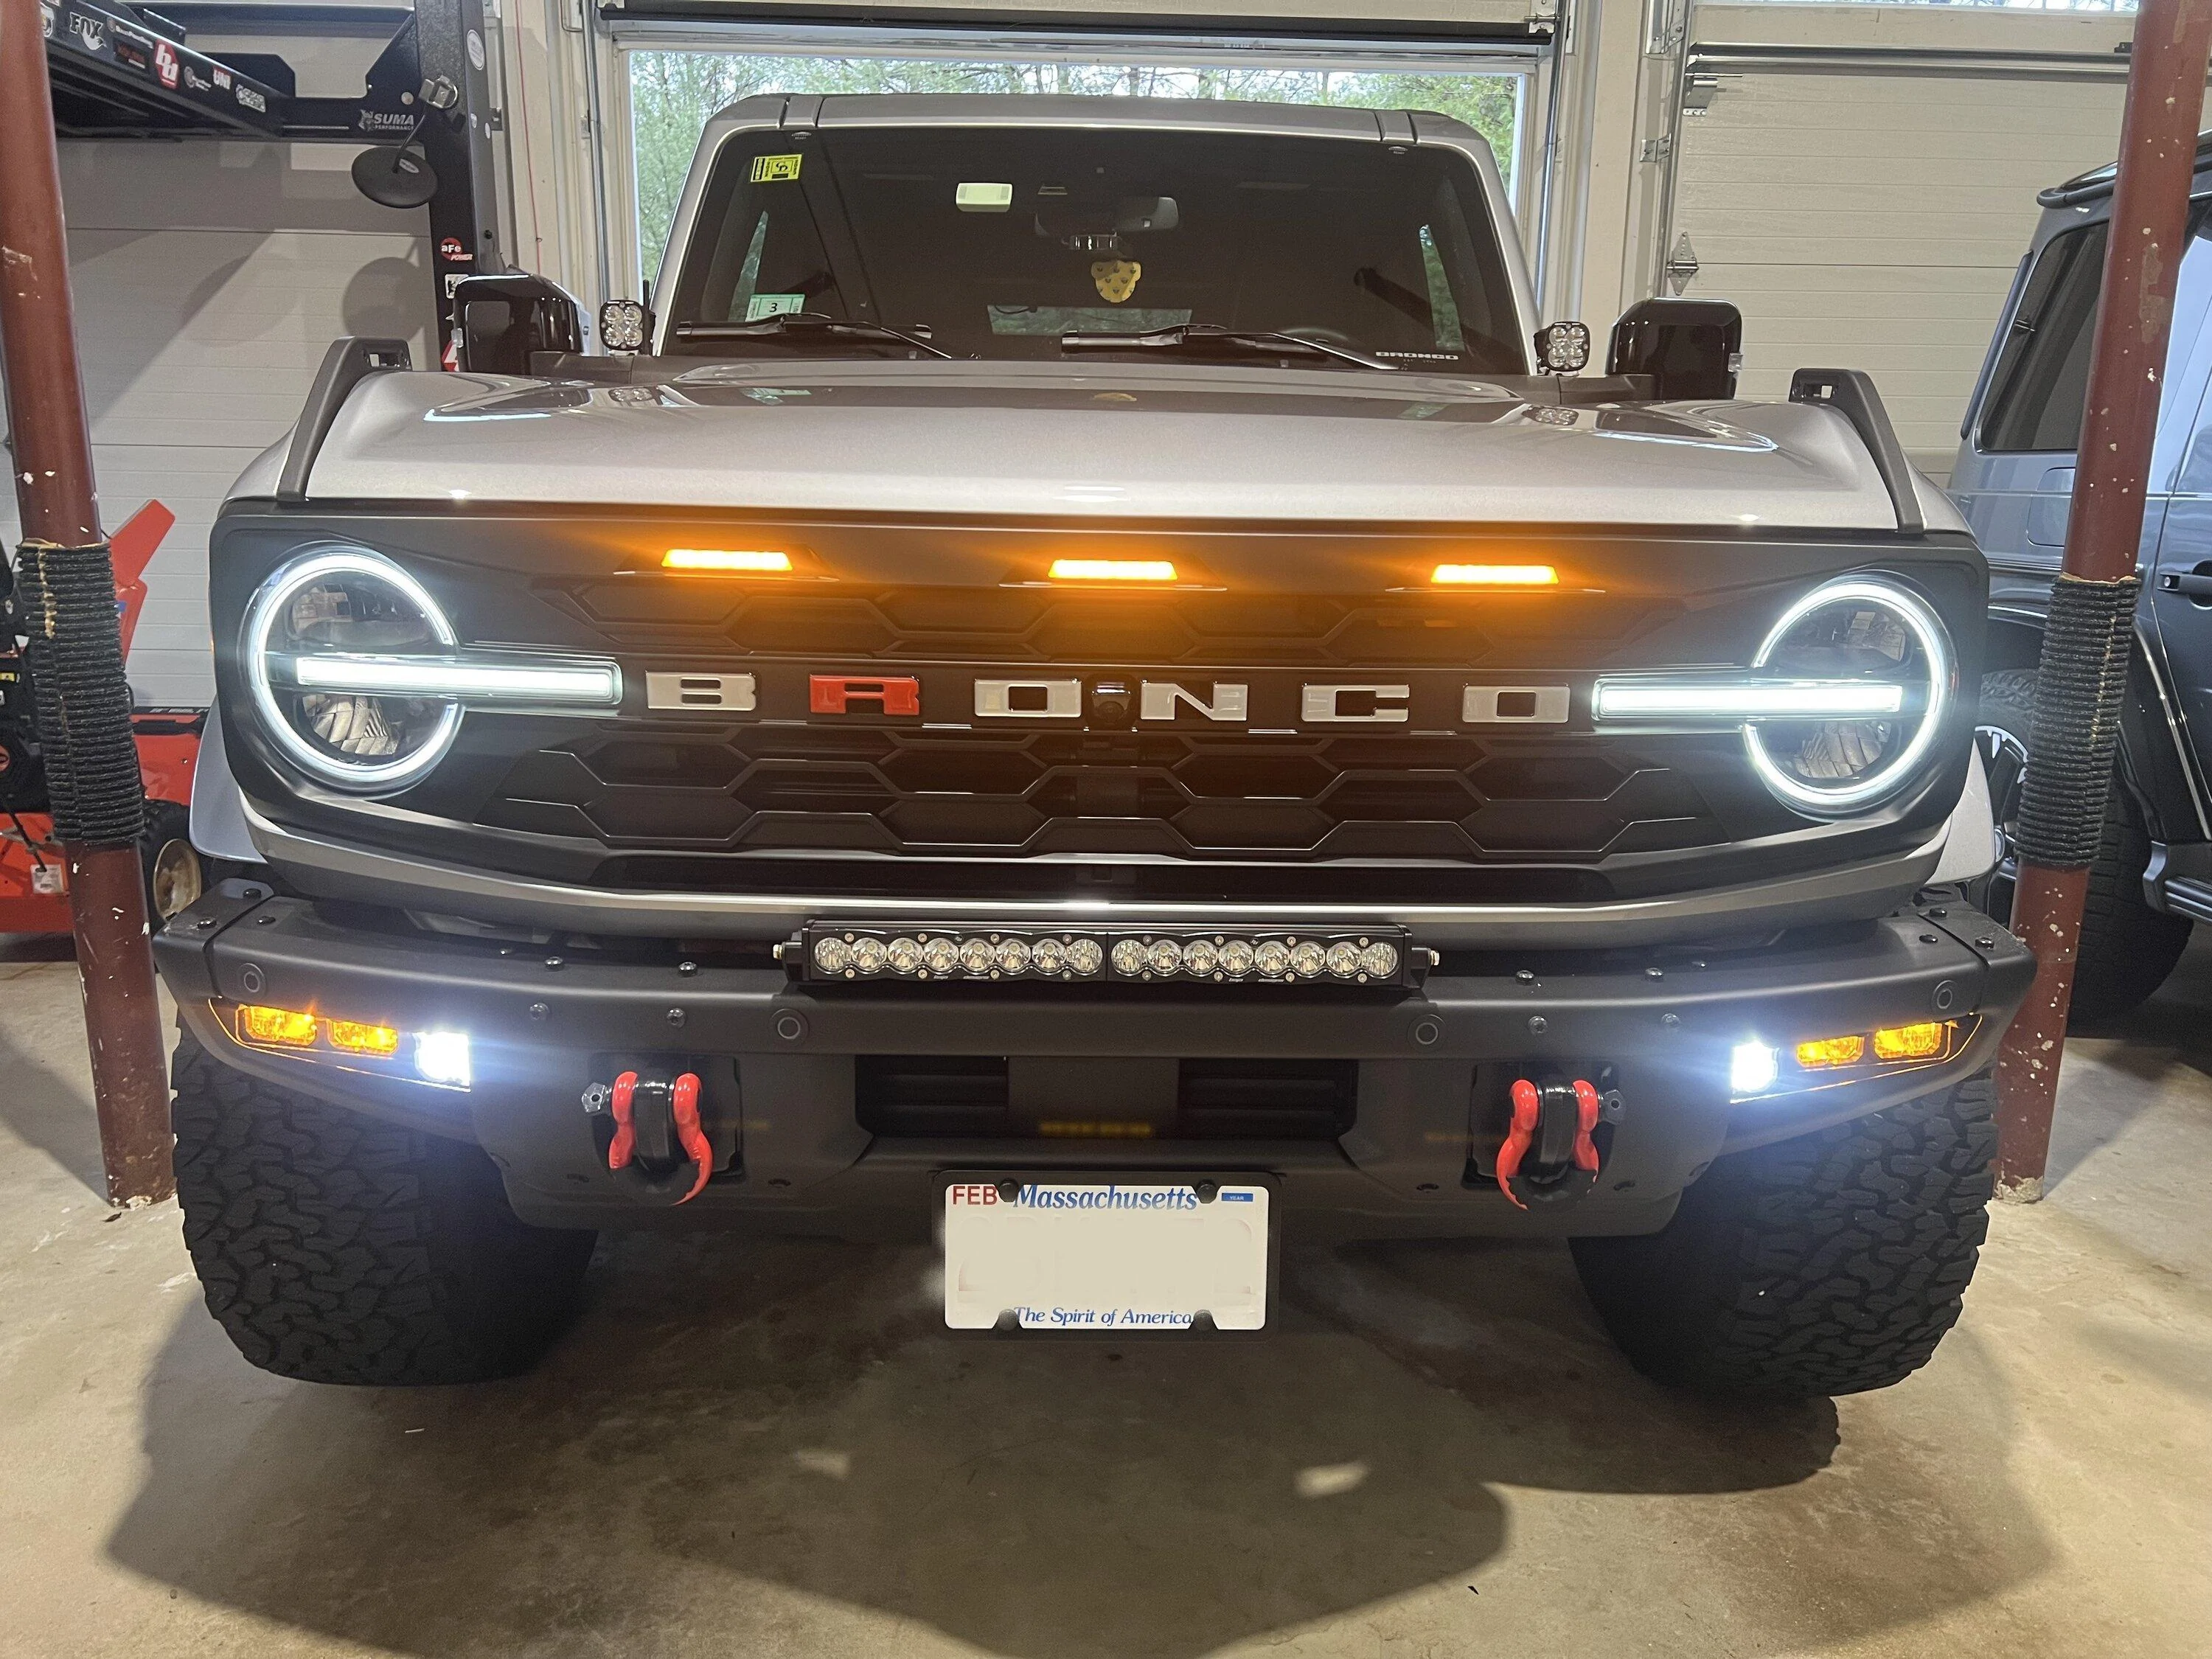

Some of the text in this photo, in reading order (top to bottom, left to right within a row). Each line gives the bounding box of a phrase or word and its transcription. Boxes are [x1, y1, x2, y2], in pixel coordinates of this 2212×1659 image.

[69, 12, 104, 41] FOX
[374, 113, 414, 125] SUMA
[441, 244, 461, 253] aFe
[769, 302, 778, 313] 3
[645, 669, 1571, 725] BRONCO
[953, 1185, 998, 1206] FEB
[1013, 1184, 1198, 1211] Massachusetts
[1014, 1307, 1192, 1326] The Spirit of America
